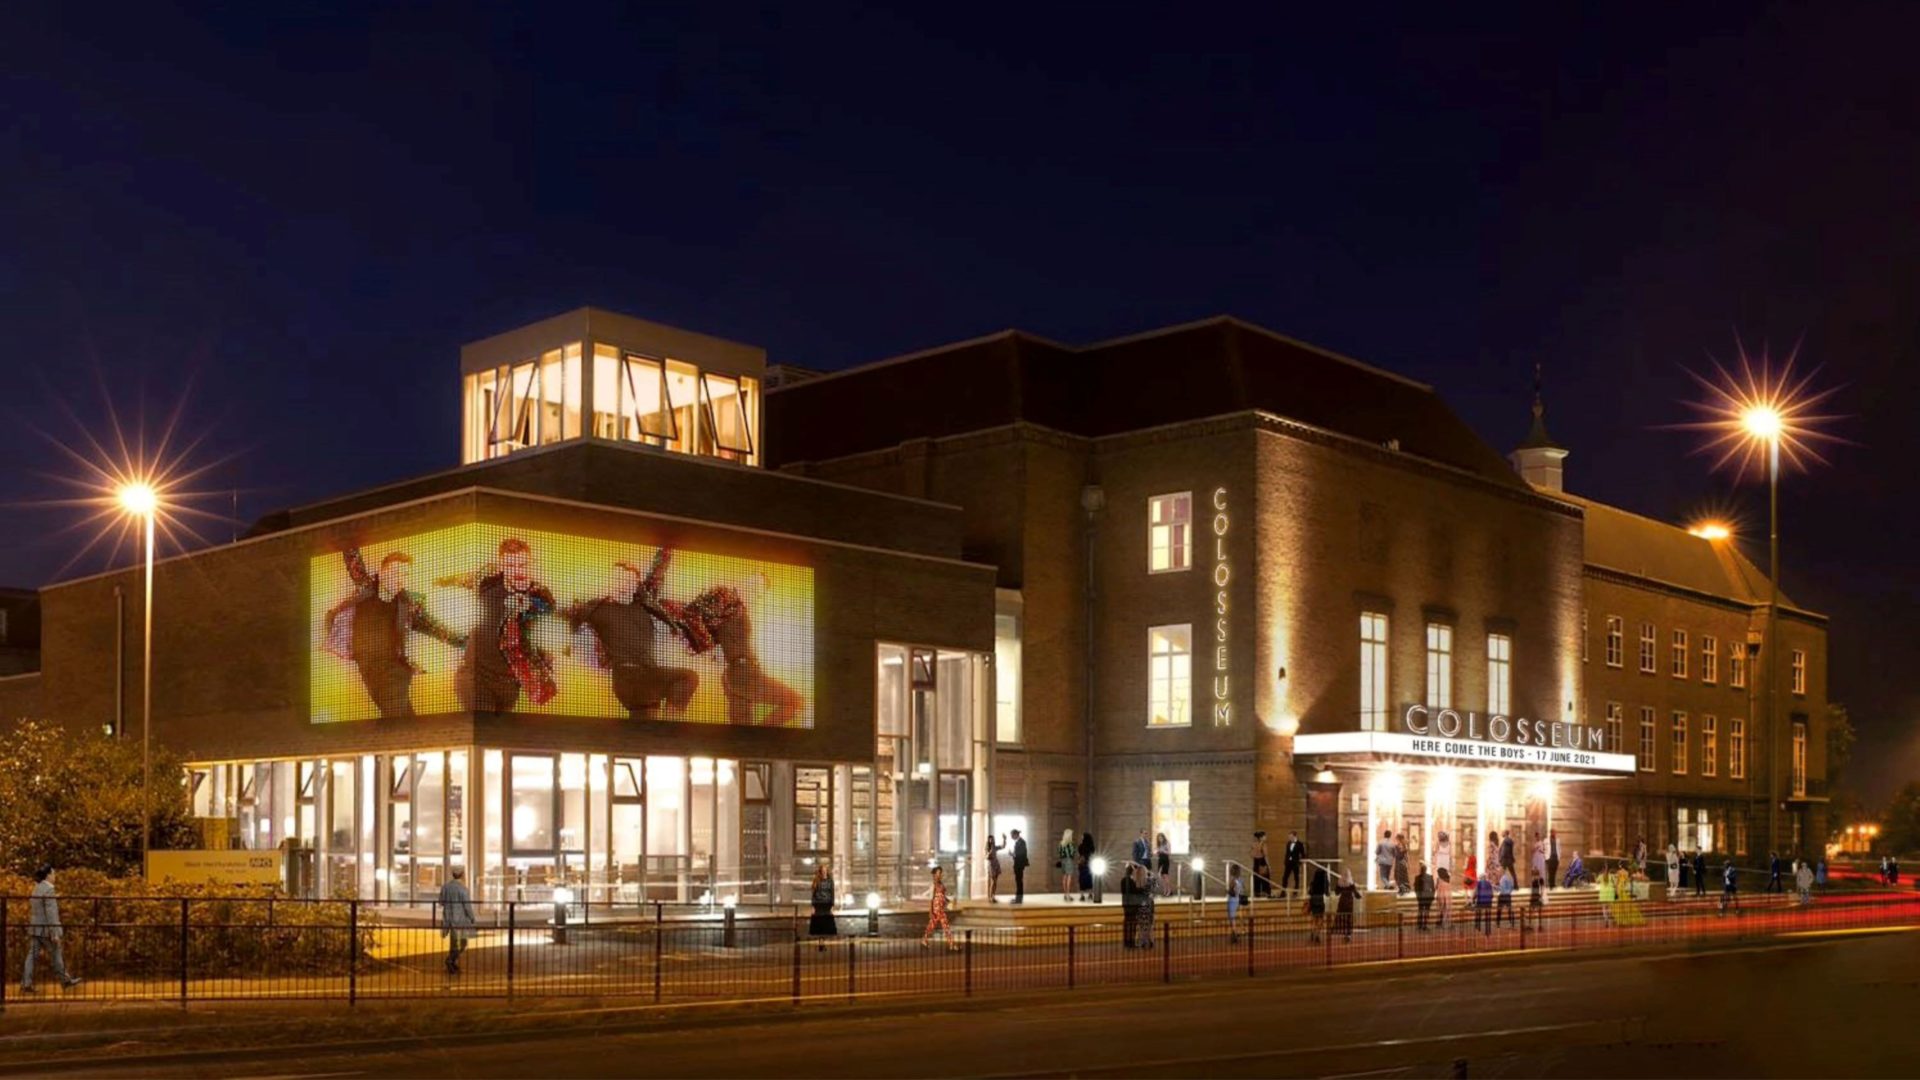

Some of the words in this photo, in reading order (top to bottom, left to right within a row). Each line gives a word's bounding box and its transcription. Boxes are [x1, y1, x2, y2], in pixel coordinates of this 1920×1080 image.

[1213, 487, 1230, 726] COLOSSEUM
[1406, 704, 1603, 750] COLOSSEUM
[1413, 740, 1440, 752] HERE
[1445, 743, 1474, 755] COME
[1477, 745, 1497, 756] THE
[1500, 747, 1525, 759] BOYS
[1536, 750, 1547, 760] 17
[1550, 751, 1572, 763] JUNE
[1574, 754, 1596, 765] 2021
